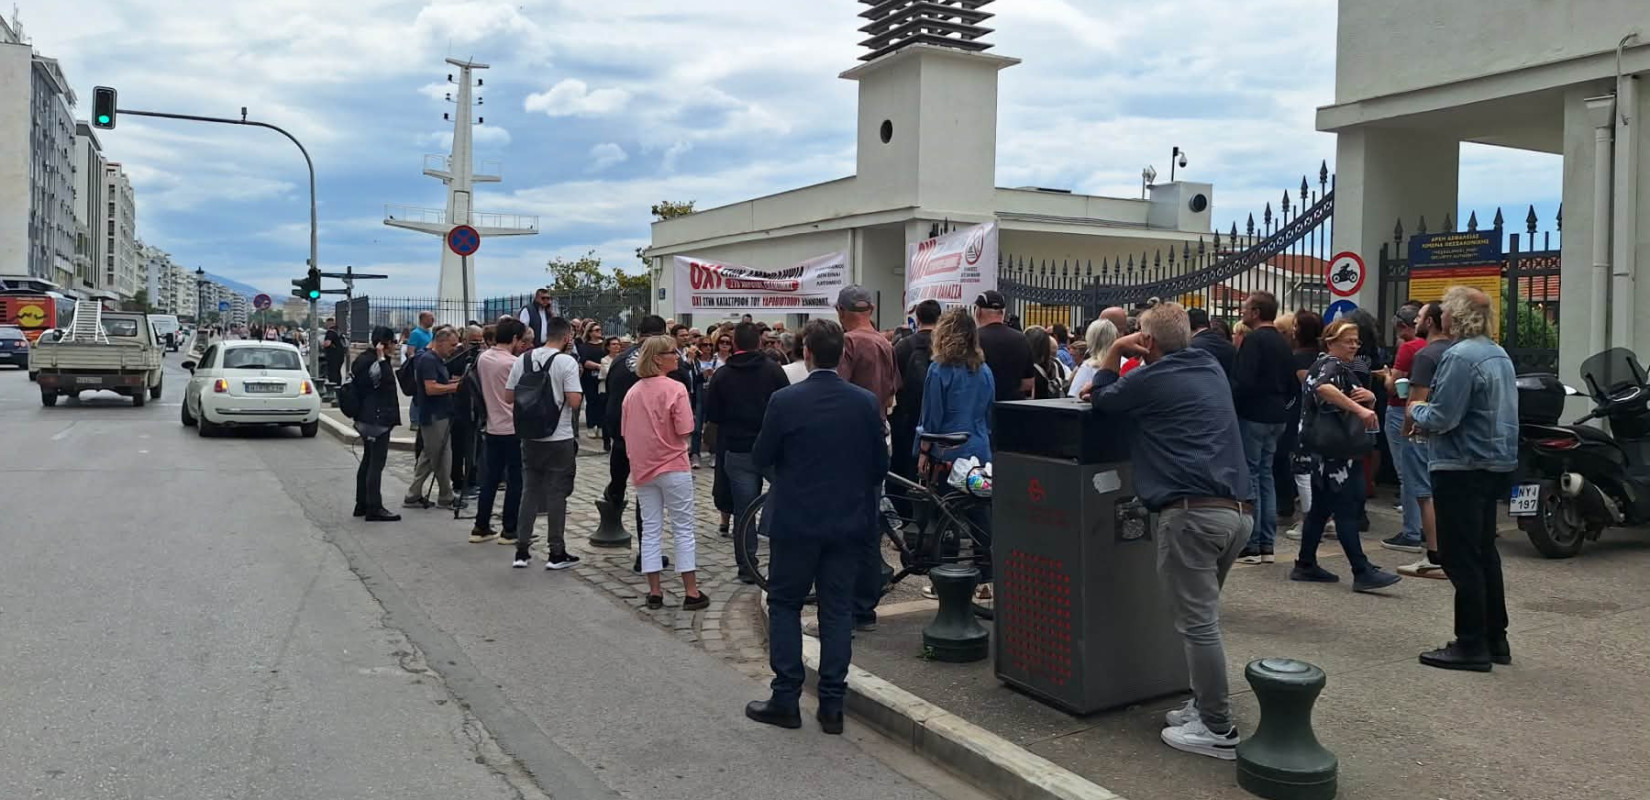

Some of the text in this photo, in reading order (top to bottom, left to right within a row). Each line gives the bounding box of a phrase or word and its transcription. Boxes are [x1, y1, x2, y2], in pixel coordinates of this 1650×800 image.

[690, 262, 722, 290] ΟΧΙ
[692, 296, 701, 306] ΟΧΙ
[750, 297, 760, 306] ΤΟΥ
[1518, 499, 1536, 509] 197
